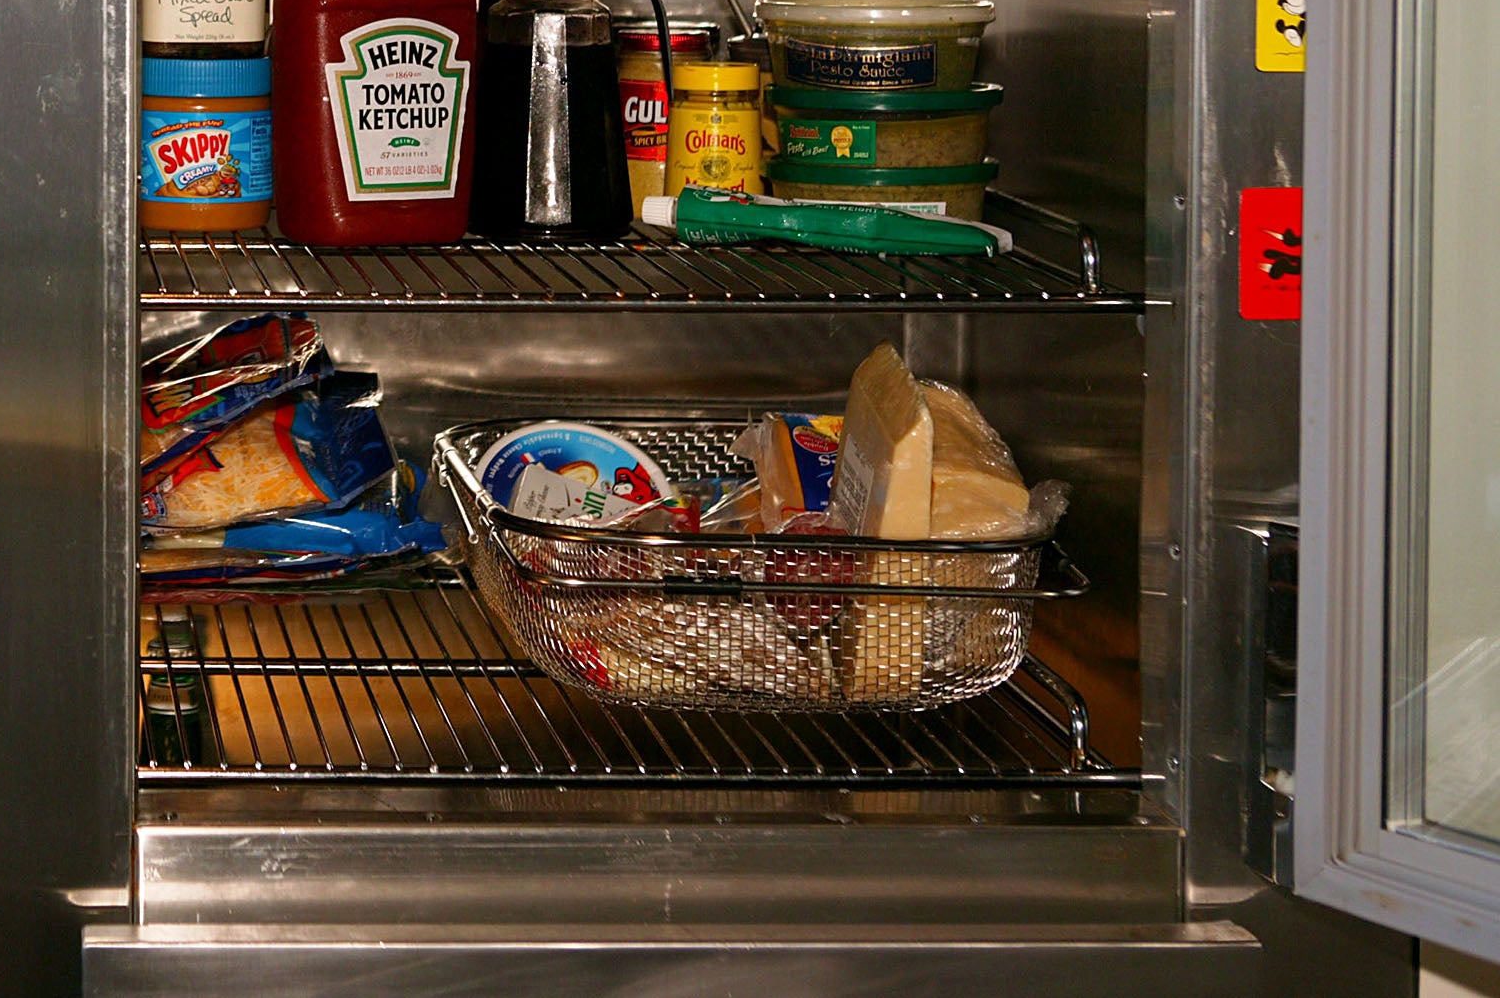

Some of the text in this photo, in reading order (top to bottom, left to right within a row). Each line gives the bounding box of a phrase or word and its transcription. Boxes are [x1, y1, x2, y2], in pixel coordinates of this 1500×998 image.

[180, 6, 234, 28] Spread
[368, 41, 438, 70] HEINZ
[812, 60, 906, 78] Pesto Sauce
[362, 82, 445, 105] TOMATO
[359, 107, 449, 130] KETCHUP
[634, 136, 655, 146] SPICY
[685, 129, 746, 156] Colman's
[158, 132, 230, 174] SKIPPY
[380, 151, 391, 159] 57
[179, 164, 216, 184] CREAMY
[365, 166, 375, 176] NET
[503, 441, 523, 458] Cheese
